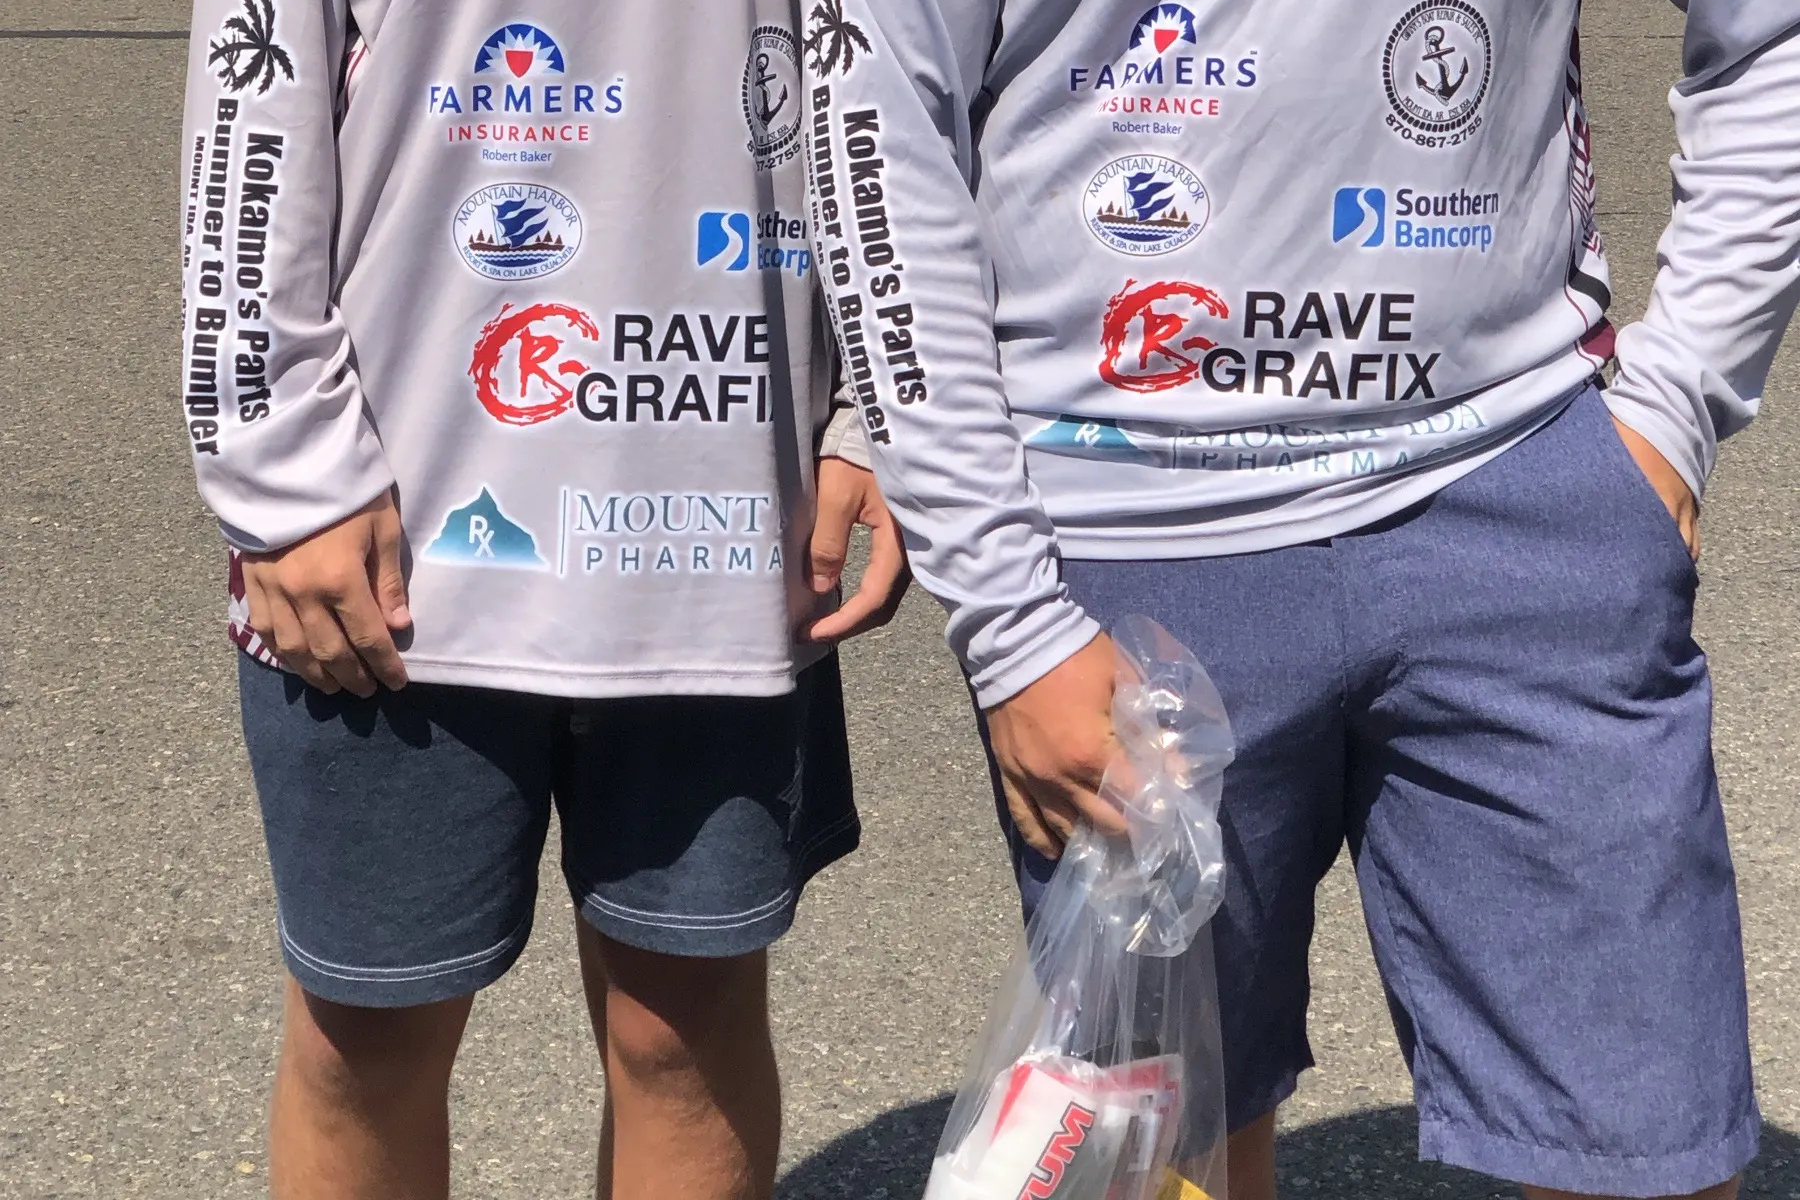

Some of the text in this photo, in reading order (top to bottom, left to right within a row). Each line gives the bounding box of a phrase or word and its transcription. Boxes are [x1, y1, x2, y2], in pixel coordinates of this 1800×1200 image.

[1070, 57, 1256, 91] FARMERS
[429, 84, 623, 114] FARMERS
[449, 124, 589, 142] INSURANCE
[1112, 122, 1182, 134] Robert Baker
[1385, 113, 1483, 148] 870-867-2755
[190, 136, 205, 200] MOUNT
[482, 149, 552, 162] Robert Baker
[811, 84, 844, 242] Bumper
[1089, 158, 1205, 204] MOUNTAIN HARBOR
[458, 186, 577, 227] MOUNTAIN HARBOR
[1396, 188, 1499, 217] Southern
[1090, 217, 1111, 240] RESORT
[1116, 240, 1127, 249] SPA
[1128, 243, 1141, 252] ON
[1143, 244, 1162, 253] LAKE
[1164, 223, 1200, 249] OUACHITA
[1395, 220, 1491, 253] Bancorp
[185, 98, 239, 456] Bumper to Bumper
[235, 132, 284, 423] Kokamo's Parts
[462, 245, 483, 269] RESORT
[488, 268, 501, 276] SPA
[503, 268, 516, 277] ON
[520, 267, 538, 277] LAKE
[540, 246, 574, 272] OUACHITA
[828, 245, 851, 287] to
[843, 108, 904, 298] Kokamo's
[877, 302, 928, 406] Parts
[1244, 290, 1415, 341] RAVE
[613, 313, 769, 363] RAVE
[838, 292, 890, 447] Bumper
[1202, 347, 1441, 400] GRAFIX
[576, 372, 775, 422] GRAFI
[575, 494, 768, 533] MOUNT
[587, 545, 783, 571] PHARMA
